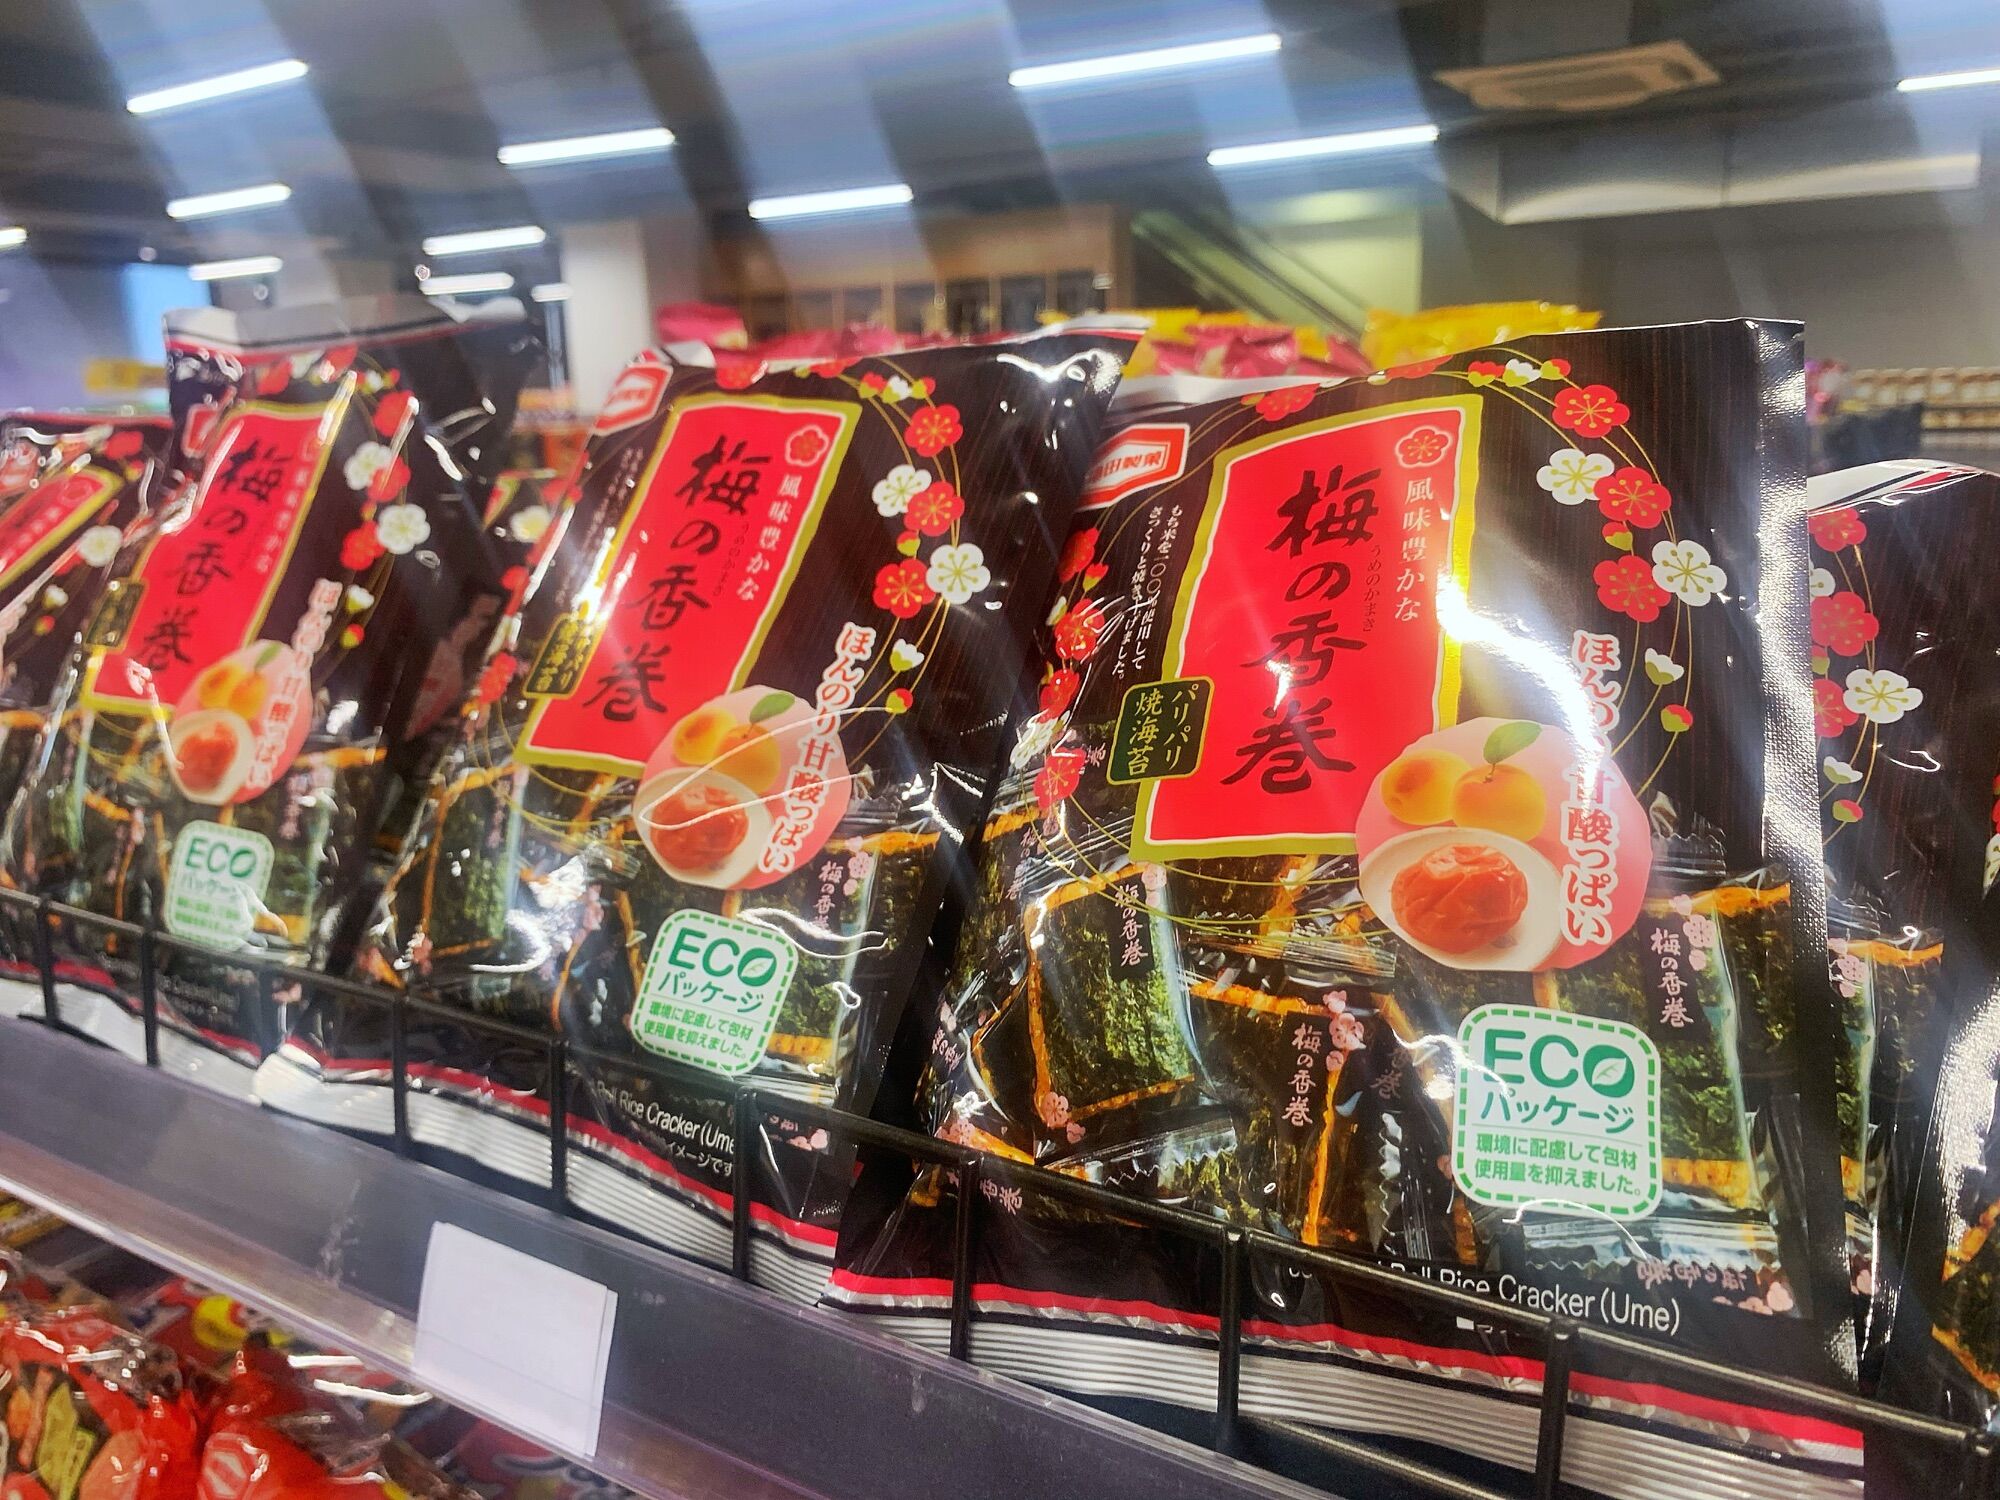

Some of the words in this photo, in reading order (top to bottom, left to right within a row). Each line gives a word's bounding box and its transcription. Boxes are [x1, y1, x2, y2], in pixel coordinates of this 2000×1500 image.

[583, 435, 771, 721] 梅の香巻
[1395, 478, 1433, 621] 風味豊かな
[1220, 464, 1382, 794] 梅の香巻
[761, 626, 873, 870] ほんのり甘酸っぱい
[1127, 687, 1163, 776] 焼海苔
[1163, 683, 1199, 770] パリパリ
[185, 837, 257, 878] ECO
[668, 927, 777, 987] ECO
[1115, 883, 1148, 967] 梅の香巻
[658, 971, 764, 1013] パッケージ
[1650, 927, 1694, 1028] 梅の香巻
[1282, 1022, 1322, 1127] 梅の香巻
[1483, 1028, 1635, 1098] ECO
[647, 1102, 700, 1140] Cracker
[1481, 1087, 1634, 1134] パッケージ
[1474, 1158, 1641, 1197] 使用量を抑えました。
[1476, 1133, 1637, 1171] 環境に配慮して包材
[1499, 1274, 1595, 1318] Cracker
[1601, 1287, 1680, 1336] (Ume)
